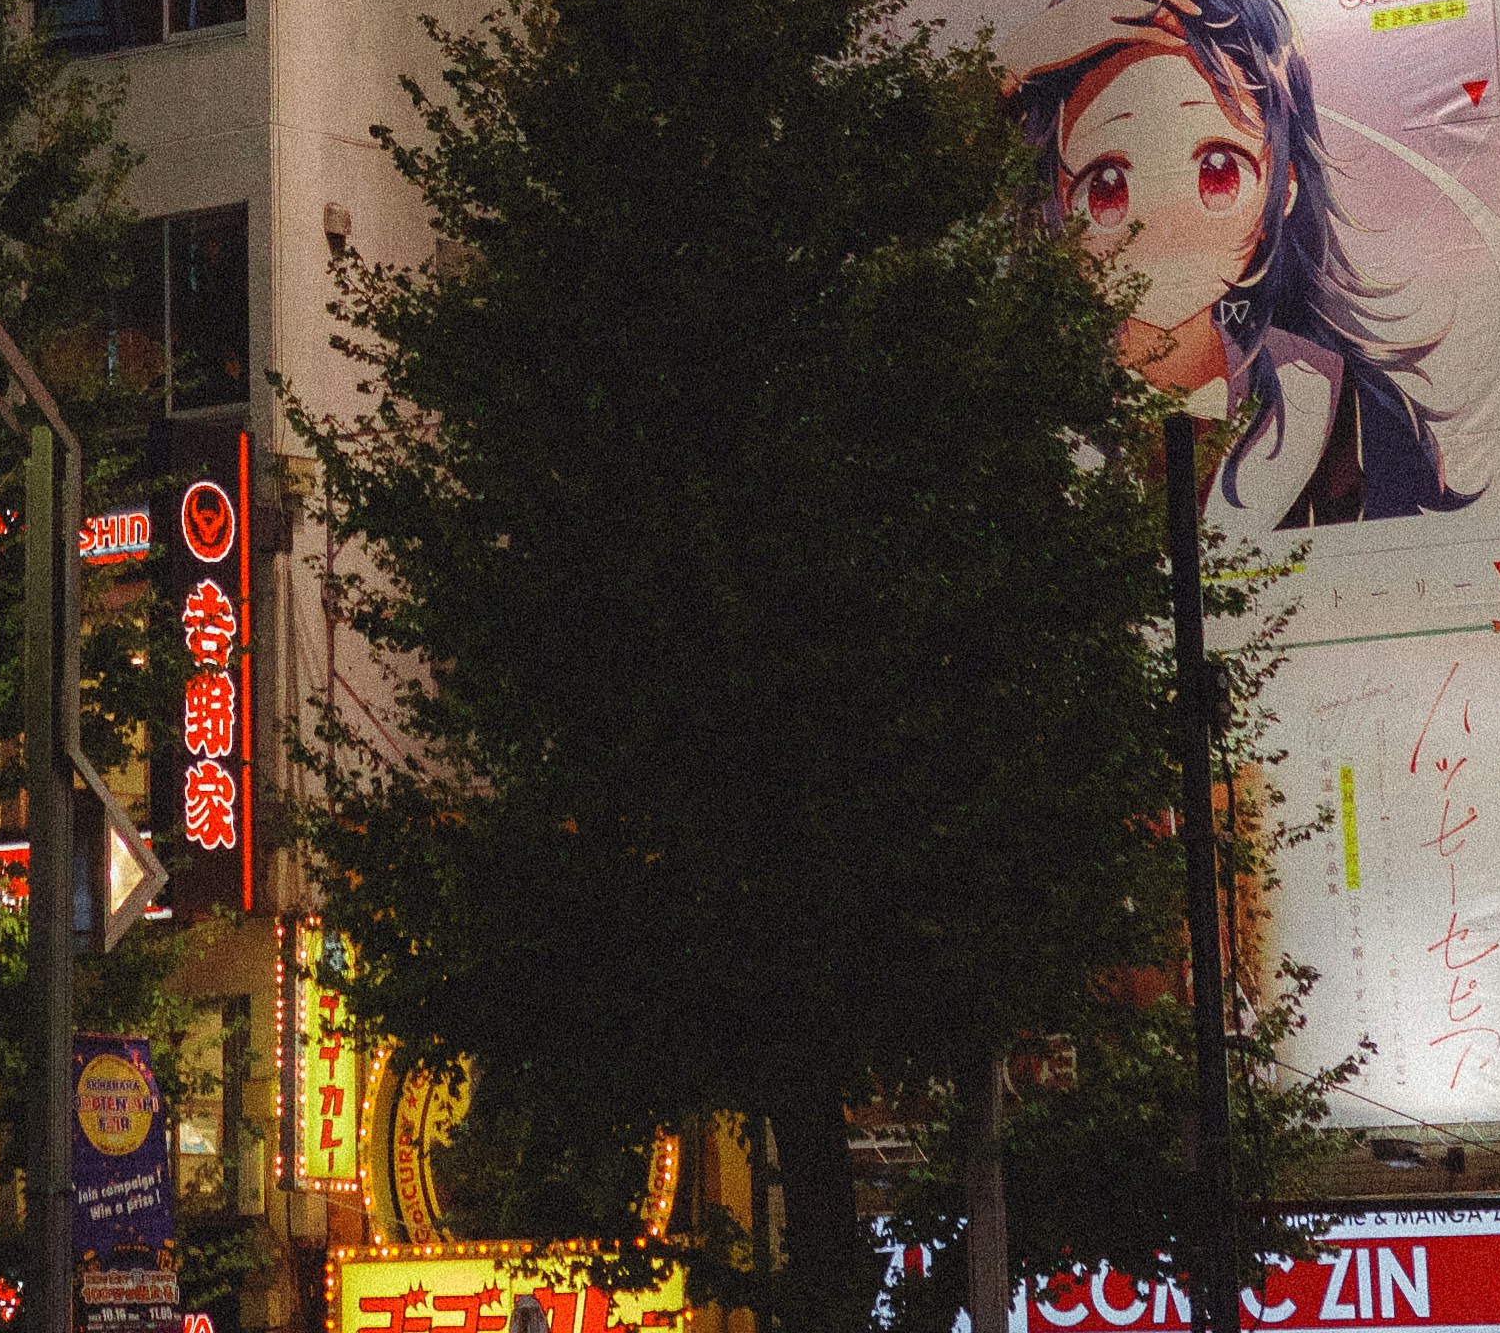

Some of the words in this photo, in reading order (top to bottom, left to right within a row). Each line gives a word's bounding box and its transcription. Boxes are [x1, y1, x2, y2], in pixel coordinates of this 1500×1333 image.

[183, 579, 236, 850] 吉野家
[1411, 662, 1500, 1090] ハッピーセピア
[1319, 1245, 1431, 1321] ZIN
